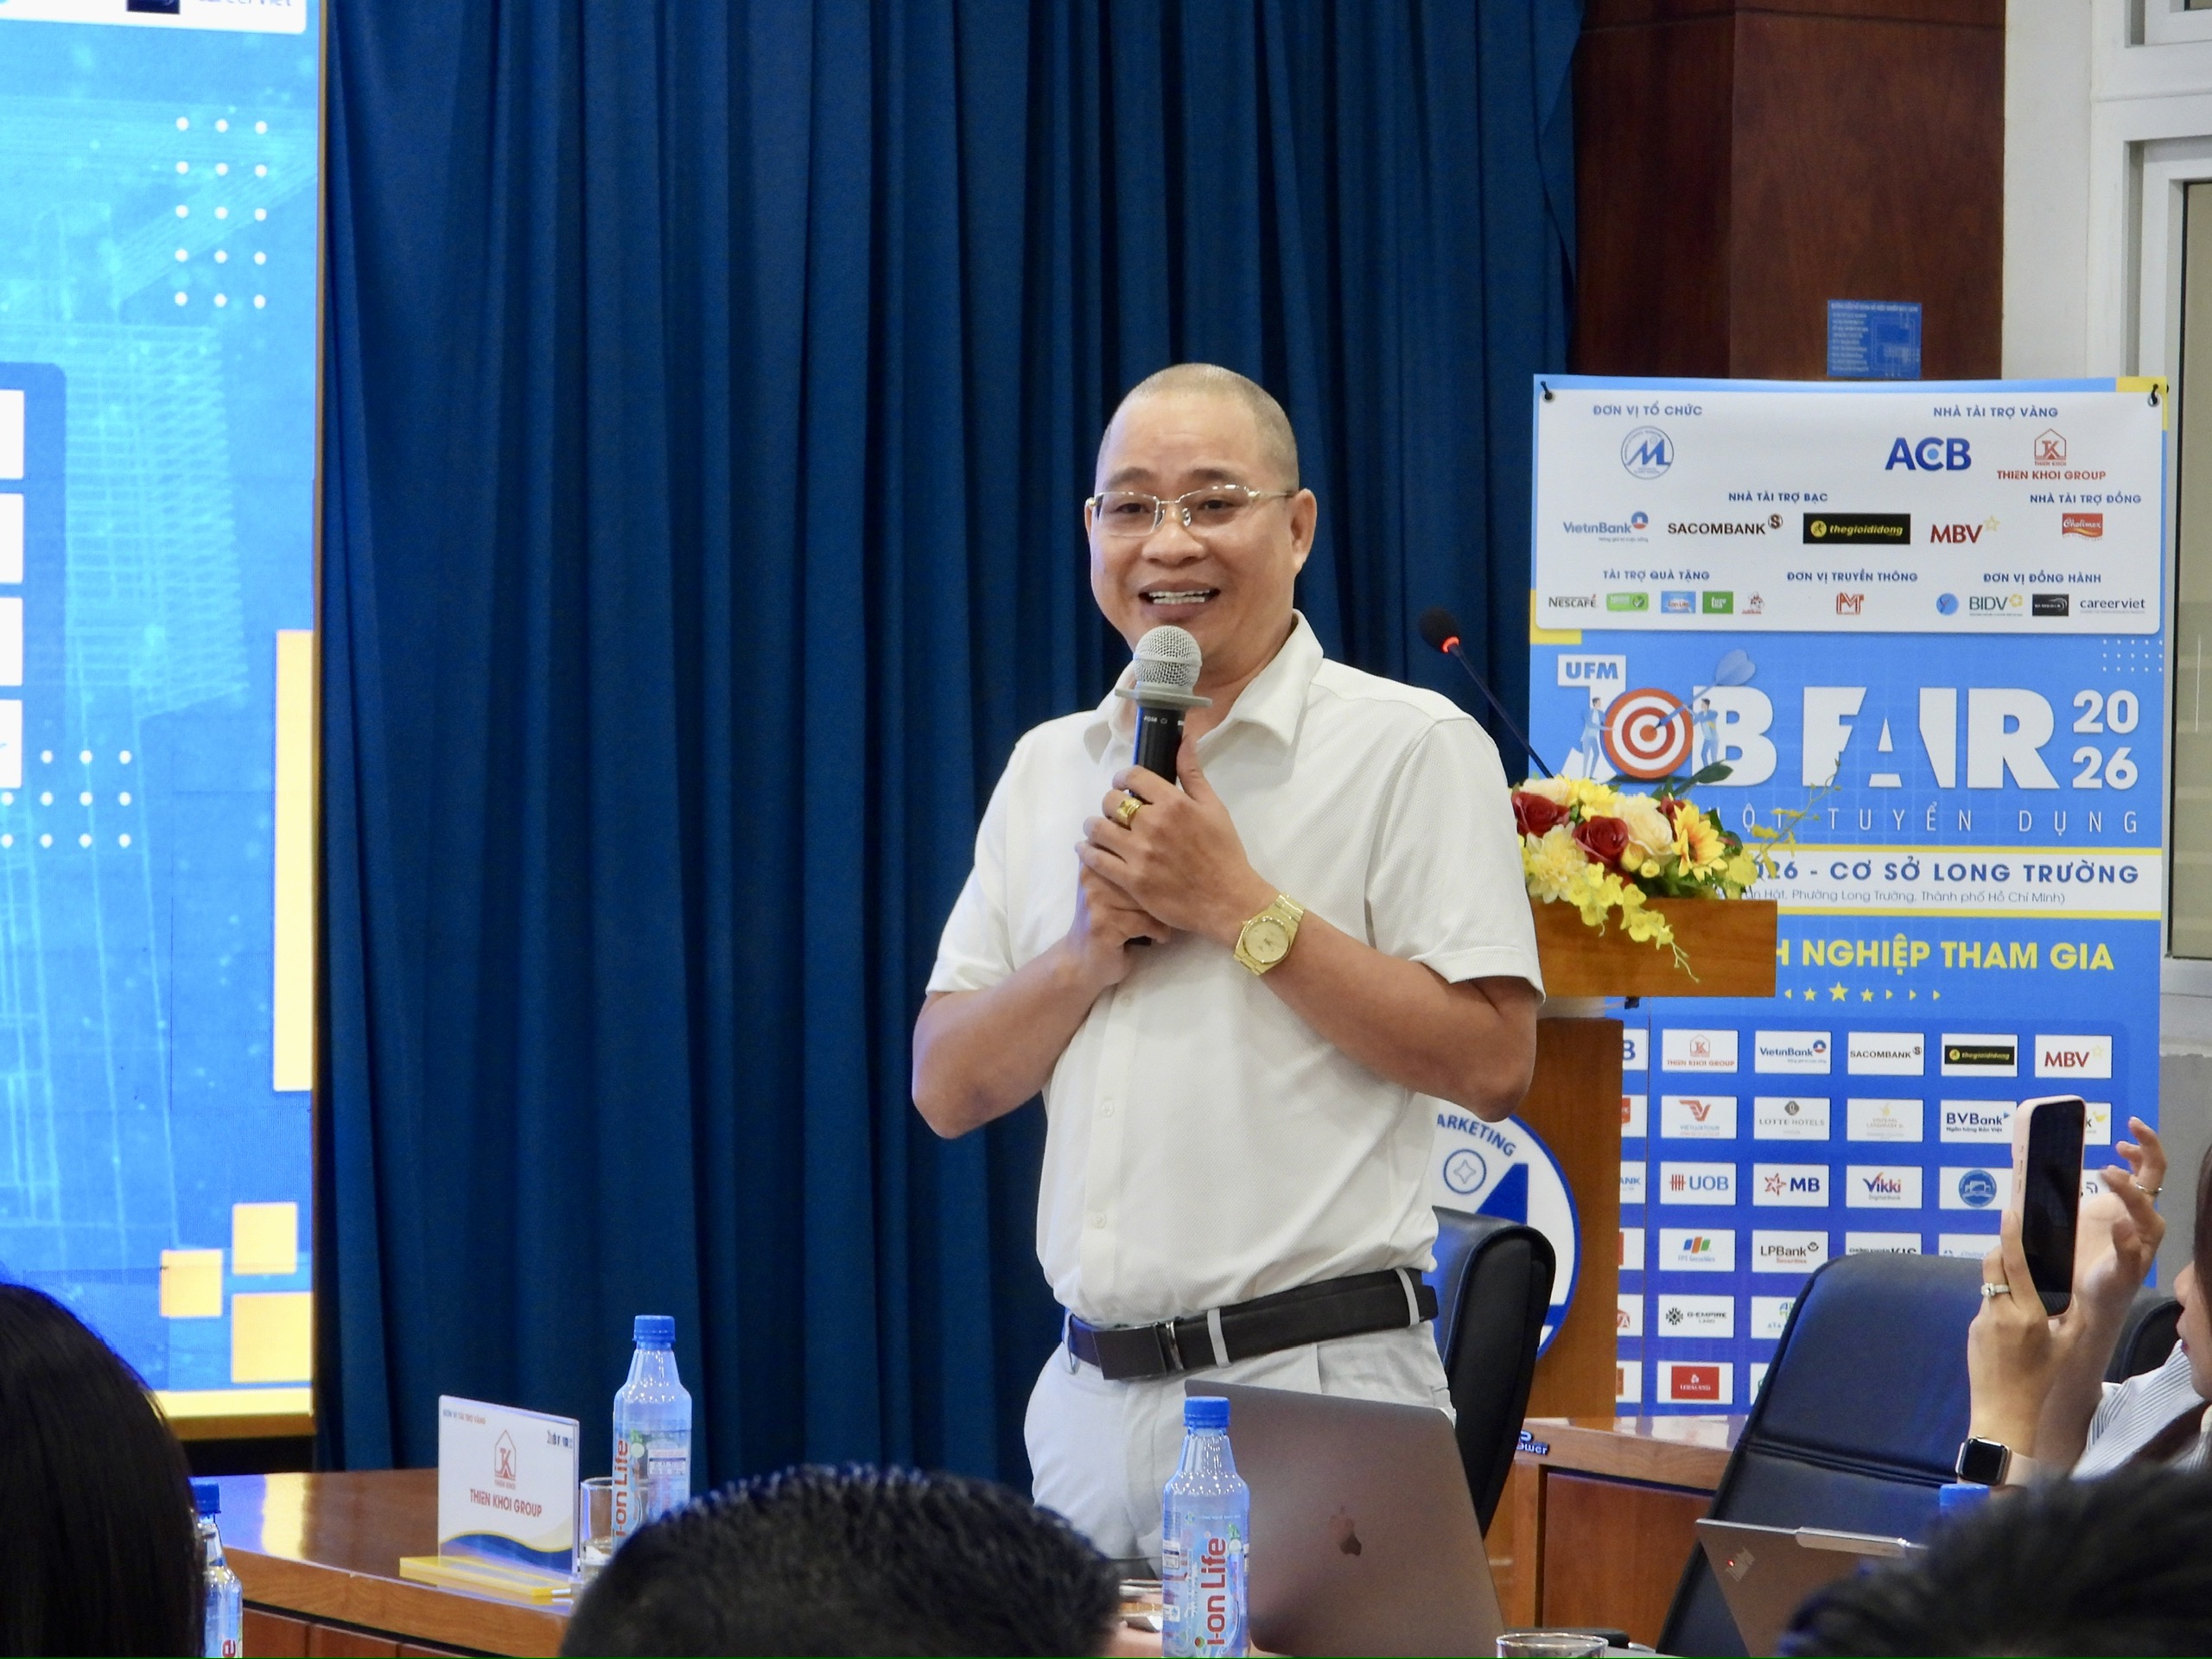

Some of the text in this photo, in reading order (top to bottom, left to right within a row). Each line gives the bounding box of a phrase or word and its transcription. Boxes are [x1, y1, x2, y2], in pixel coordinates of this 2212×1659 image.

[1593, 400, 1702, 418] ĐƠN VỊ TỔ CHỨC
[1933, 404, 2058, 420] NHÀ TÀI TRỢ VÀNG
[1885, 436, 1972, 471] ACB
[2032, 470, 2061, 480] KHOI
[2064, 470, 2107, 480] GROUP
[1728, 490, 1828, 505] NHÀ TÀI TRỢ BẠC
[2030, 490, 2142, 505] NHÀ TÀI TRỢ ĐỒNG
[1668, 523, 1765, 536] SACOMBANK
[1829, 524, 1904, 537] thegioididong
[1930, 524, 1983, 543] MBV
[1603, 569, 1710, 583] TÀI TRỢ QUÀ TẶNG
[1787, 569, 1918, 584] ĐƠN VỊ TRUYỀN THÔNG
[1983, 569, 2101, 585] ĐƠN VỊ ĐỒNG HÀNH
[1969, 596, 2008, 610] BIDV
[1565, 661, 1618, 680] UFM
[2073, 689, 2139, 734] 20
[1802, 686, 2061, 790] FAIR
[2072, 746, 2139, 791] 26
[1827, 800, 1972, 831] TUYỂN
[2018, 809, 2138, 836] DỤNG
[1830, 858, 1872, 881] CƠ
[1885, 855, 1920, 881] SỞ
[1934, 862, 2011, 882] LONG
[2023, 859, 2139, 884] TRƯỜNG
[1792, 888, 1838, 902] Phường
[1841, 889, 1872, 903] Long
[1922, 890, 1957, 901] Thành
[1961, 890, 1985, 904] phố
[1988, 890, 2005, 902] Hồ
[2008, 891, 2029, 903] Chí
[2032, 892, 2066, 905] Minh)
[1802, 932, 1931, 976] NGHIỆP
[1941, 941, 2037, 969] THAM
[2050, 942, 2115, 970] GIA
[1850, 1050, 1911, 1058] SACOMBANK
[2044, 1051, 2089, 1068] MBV
[1946, 1112, 2003, 1125] BVBank
[1689, 1175, 1729, 1192] UOB
[1789, 1177, 1820, 1192] MB
[1862, 1172, 1901, 1193] Vikki
[1760, 1245, 1807, 1257] LPBank
[615, 1439, 631, 1481] Life
[493, 1494, 512, 1512] KHOI
[513, 1499, 543, 1518] GROUP
[1200, 1537, 1226, 1589] Life
